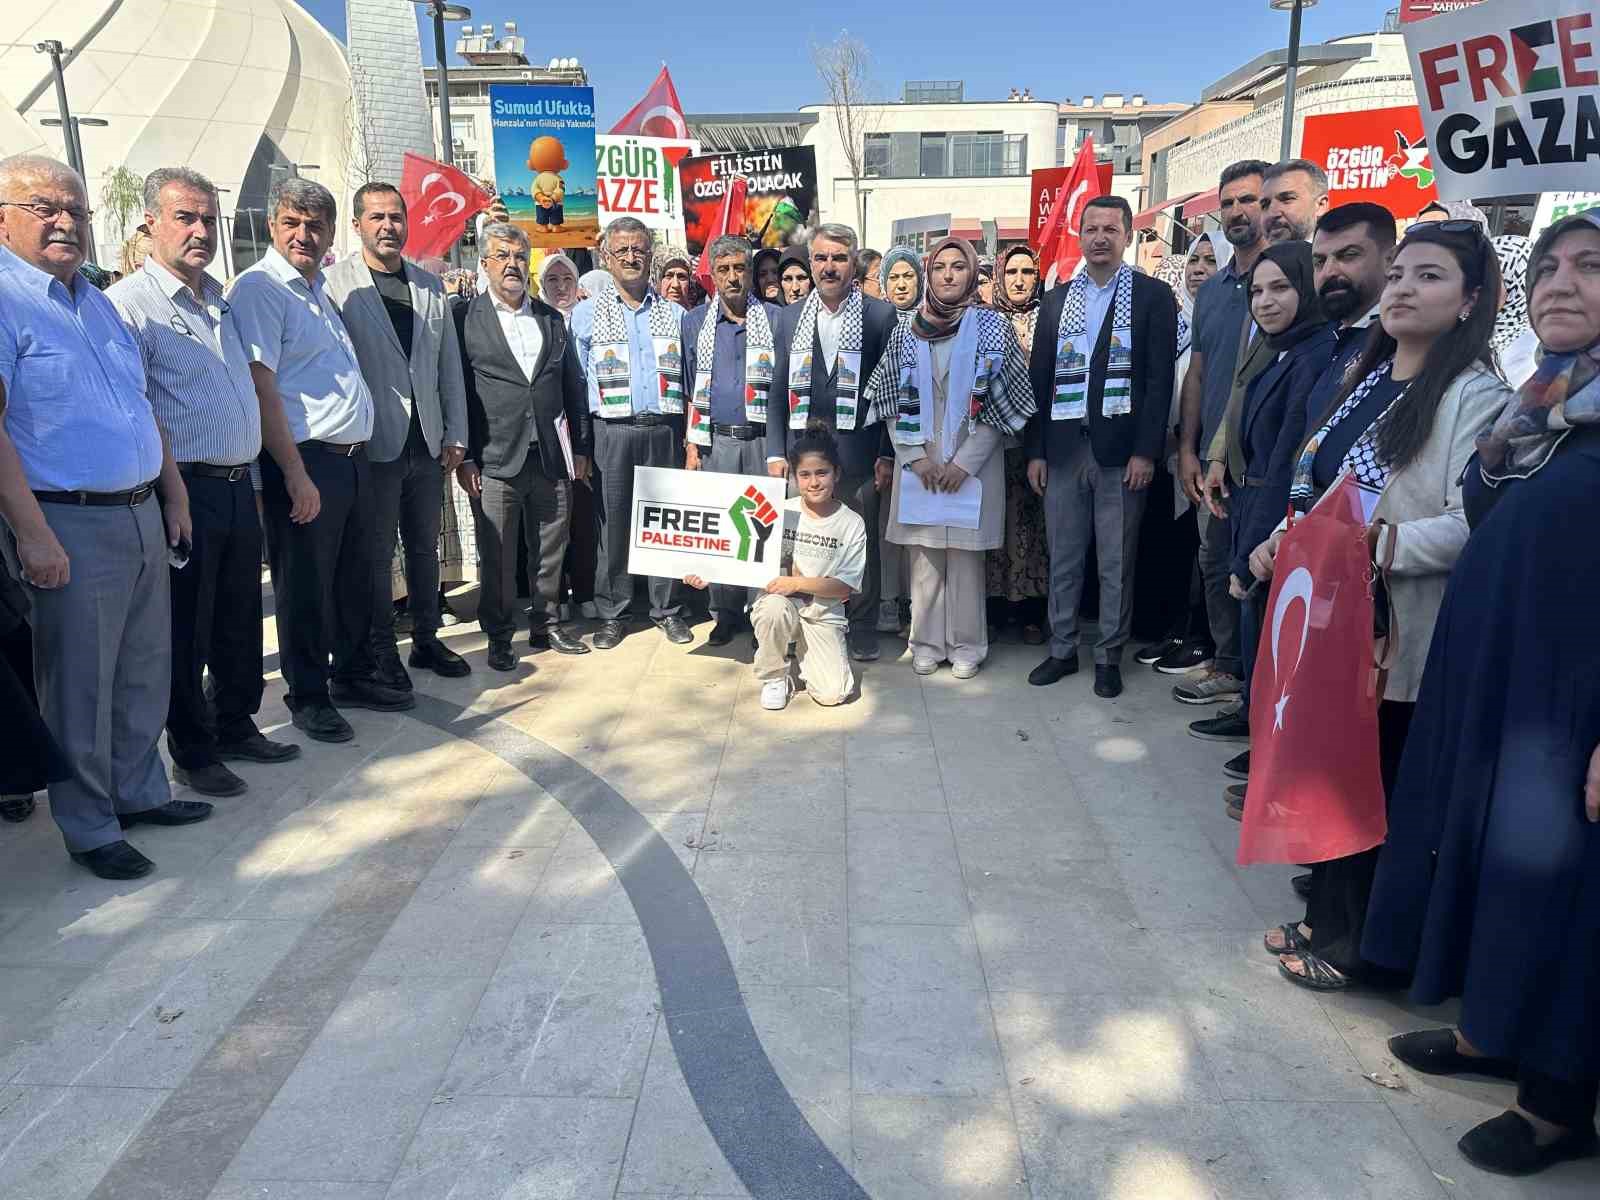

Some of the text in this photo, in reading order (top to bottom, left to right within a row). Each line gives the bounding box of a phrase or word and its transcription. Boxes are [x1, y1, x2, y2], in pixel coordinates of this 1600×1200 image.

[1419, 13, 1599, 112] FREE
[494, 100, 594, 118] Sumud Ufukta,
[1436, 95, 1600, 174] GAZA
[595, 139, 657, 178] ZGÜR
[710, 152, 783, 176] FİLİSTİN
[1327, 146, 1384, 169] ÖZGÜR
[694, 172, 803, 197] ÖZGÜ OLACAK
[1326, 166, 1389, 190] İLİSTİN
[596, 178, 659, 213] AZZE
[643, 506, 720, 534] FREE
[642, 531, 731, 552] PALESTINE
